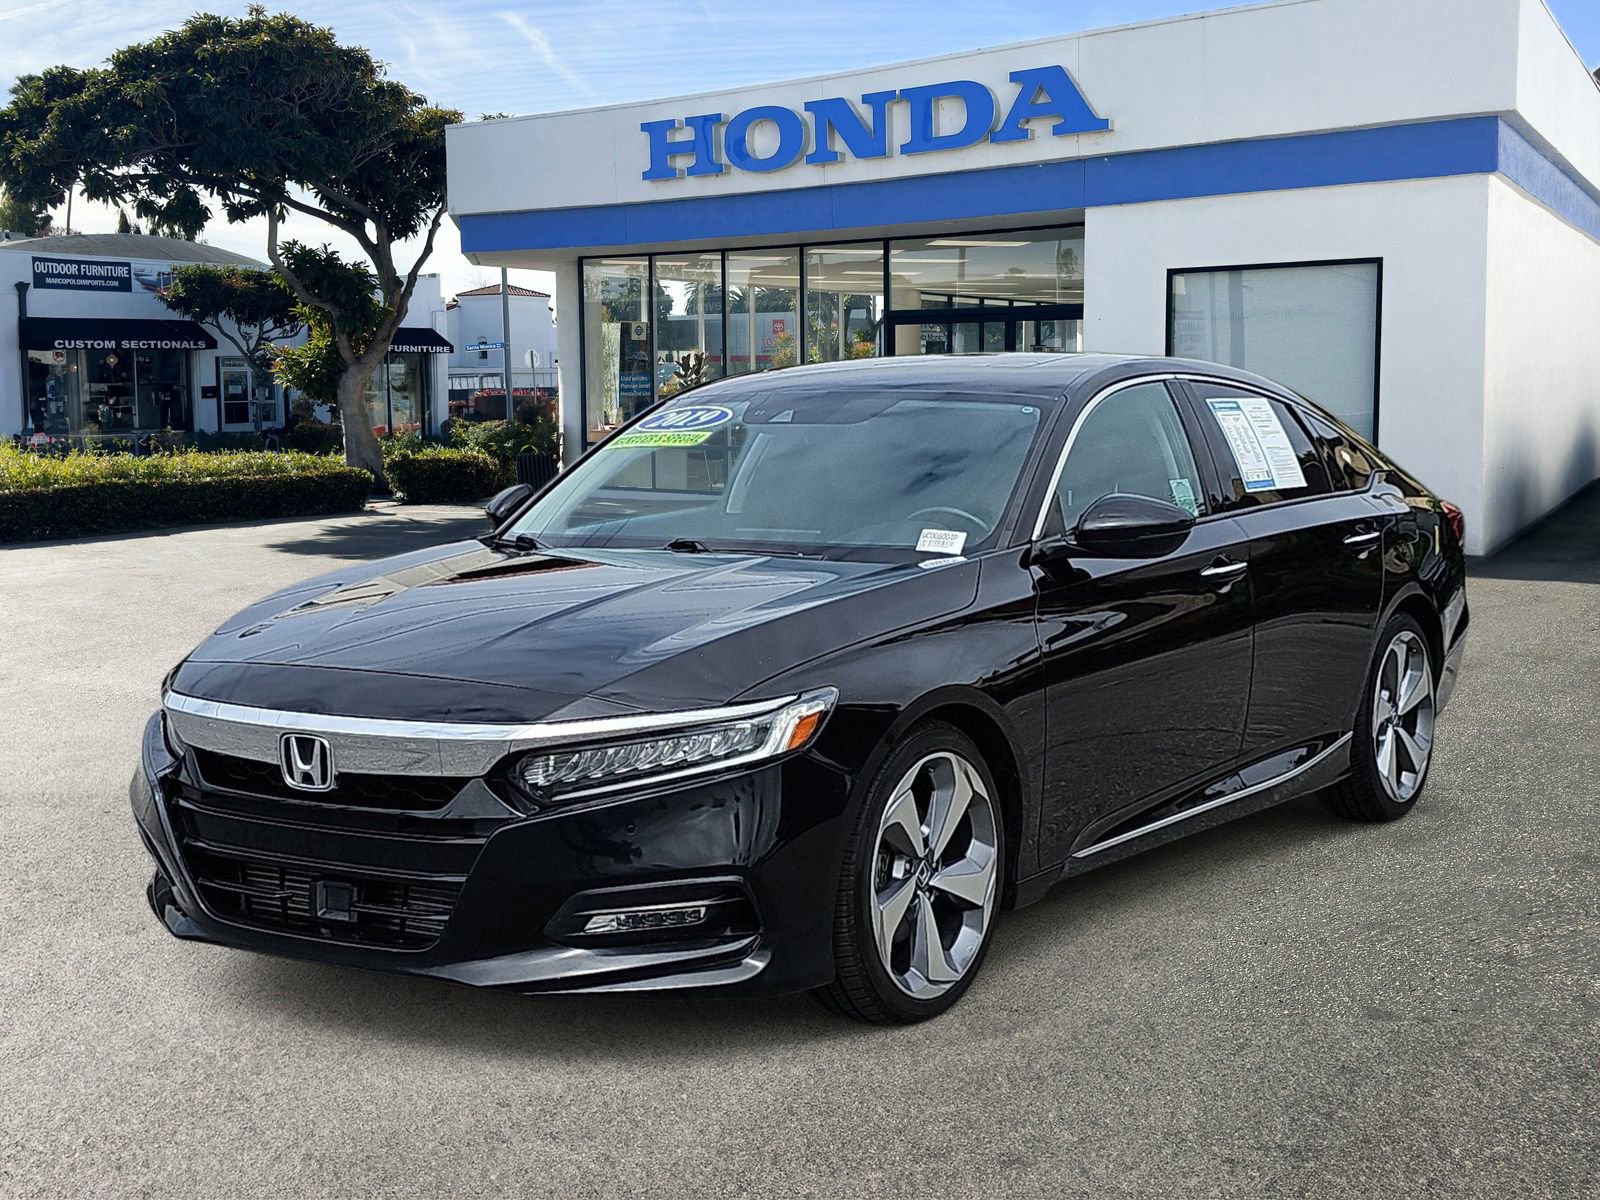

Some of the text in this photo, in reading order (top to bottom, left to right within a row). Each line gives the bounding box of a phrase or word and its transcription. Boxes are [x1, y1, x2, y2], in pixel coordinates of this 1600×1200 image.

[640, 65, 1113, 181] HONDA
[34, 261, 130, 278] OUTDOOR FURNITURE
[45, 277, 119, 287] MARCOPOLOIMPORTS.COM
[54, 339, 206, 349] CUSTOM SECTIONALS
[387, 344, 451, 353] FURNITURE
[645, 409, 722, 428] 2019
